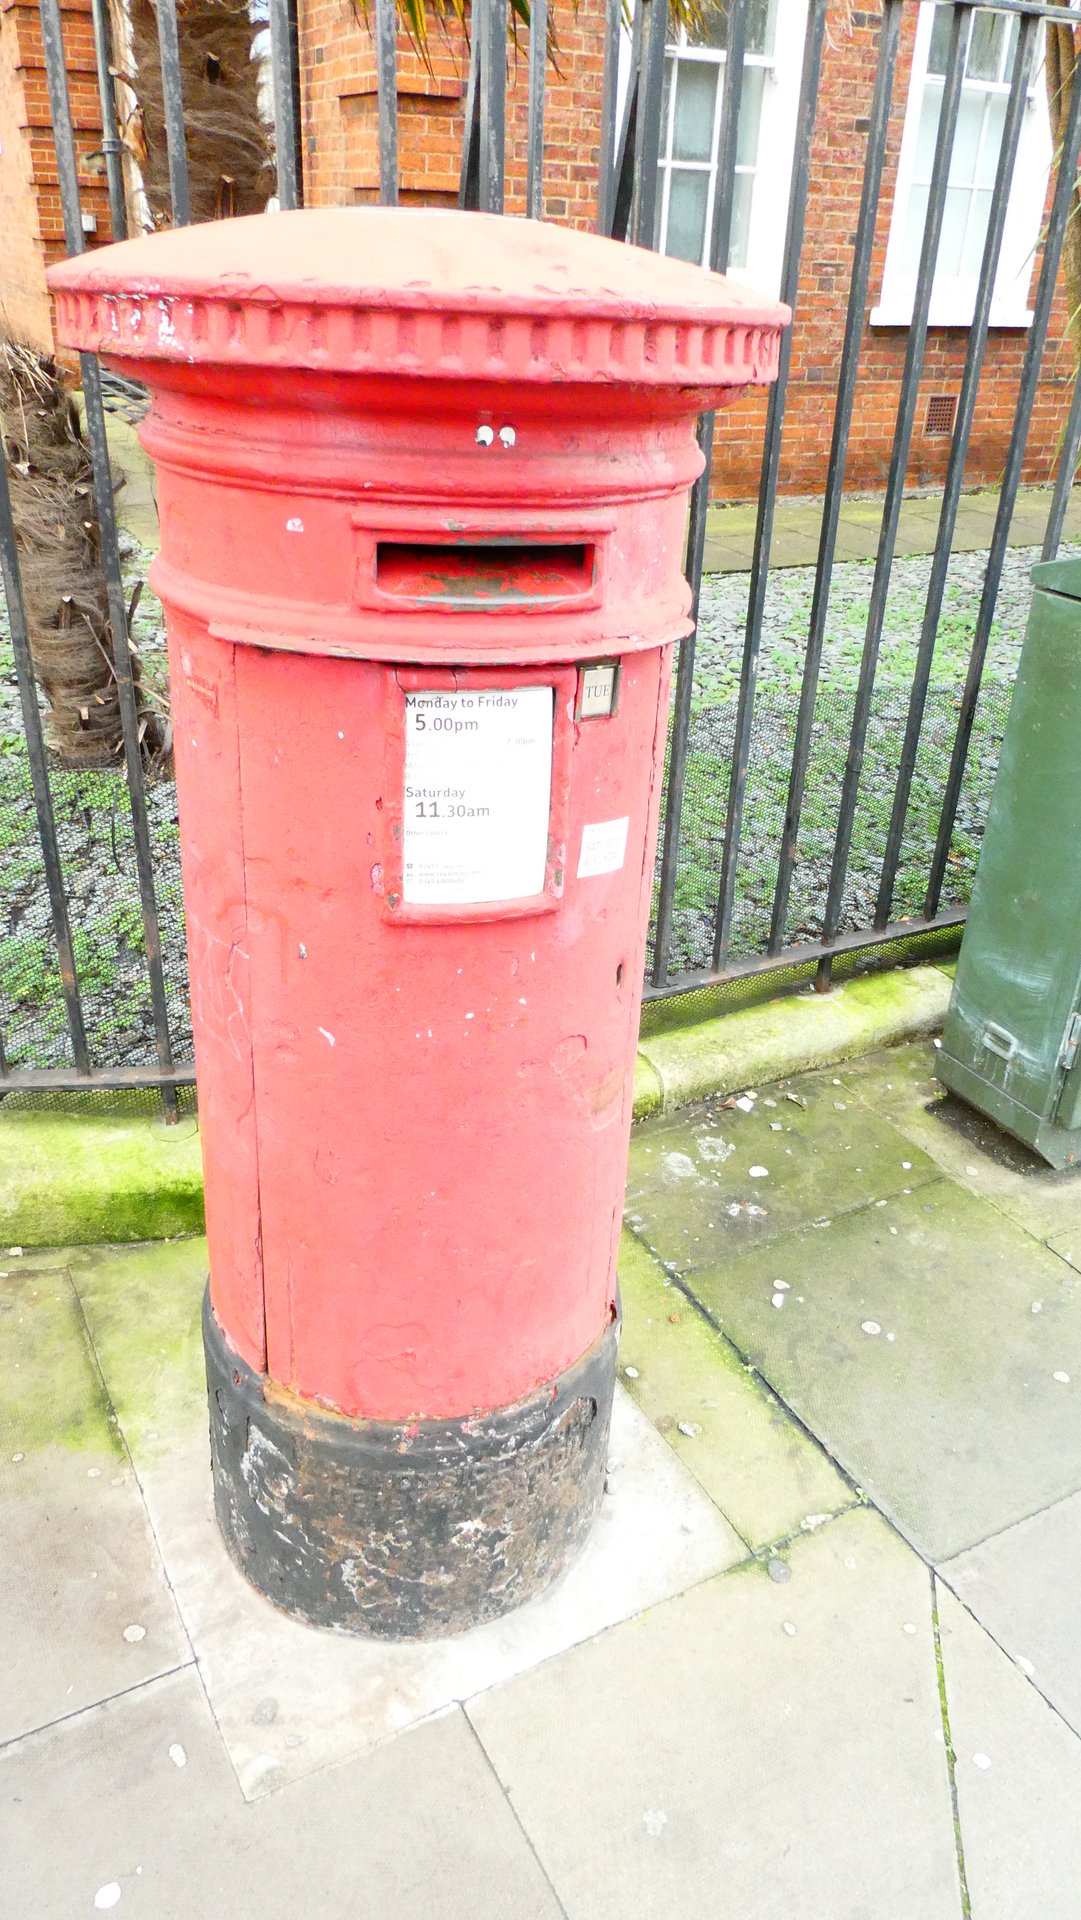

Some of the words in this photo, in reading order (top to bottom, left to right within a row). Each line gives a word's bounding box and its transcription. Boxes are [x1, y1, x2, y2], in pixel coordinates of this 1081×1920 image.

[585, 684, 611, 698] TUE
[405, 696, 457, 710] Monday
[461, 698, 474, 708] to
[478, 696, 518, 709] Friday
[415, 713, 479, 733] 5.00pm
[405, 786, 466, 800] Saturday
[415, 801, 490, 818] 11.30am
